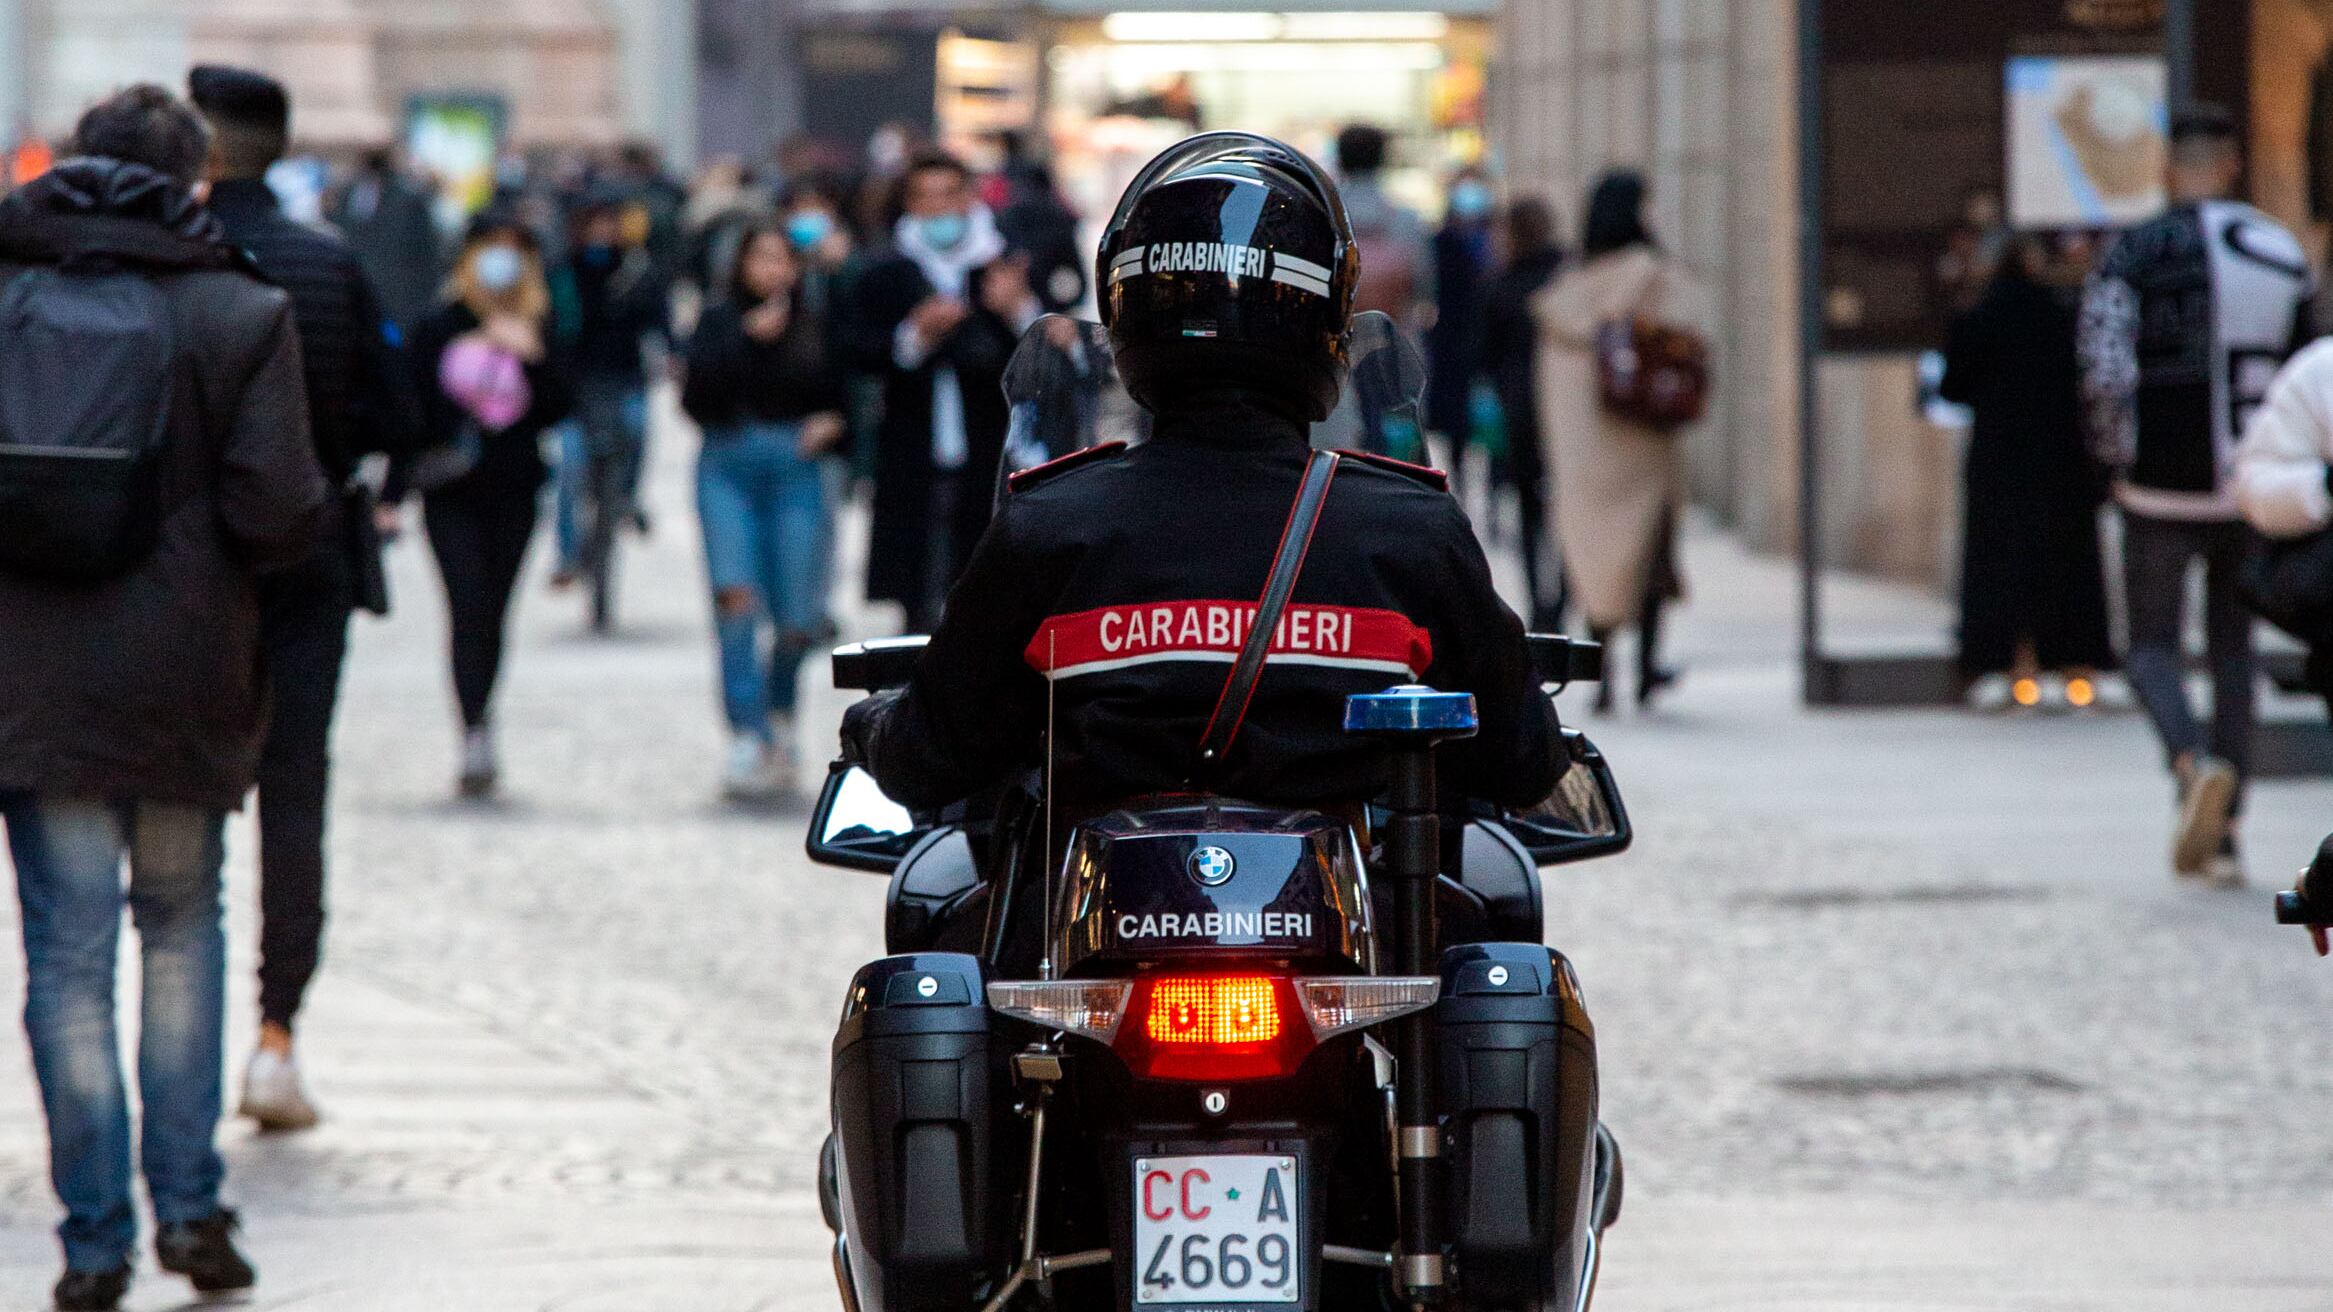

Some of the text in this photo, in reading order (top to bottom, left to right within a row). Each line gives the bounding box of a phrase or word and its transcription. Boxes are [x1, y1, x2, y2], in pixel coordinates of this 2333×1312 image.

[1149, 242, 1266, 278] CARABINIERI
[1100, 606, 1352, 652] CARABIIERI
[1118, 912, 1312, 939] CARABINIERI
[1143, 1167, 1289, 1223] CC A
[1143, 1233, 1290, 1290] 4669
